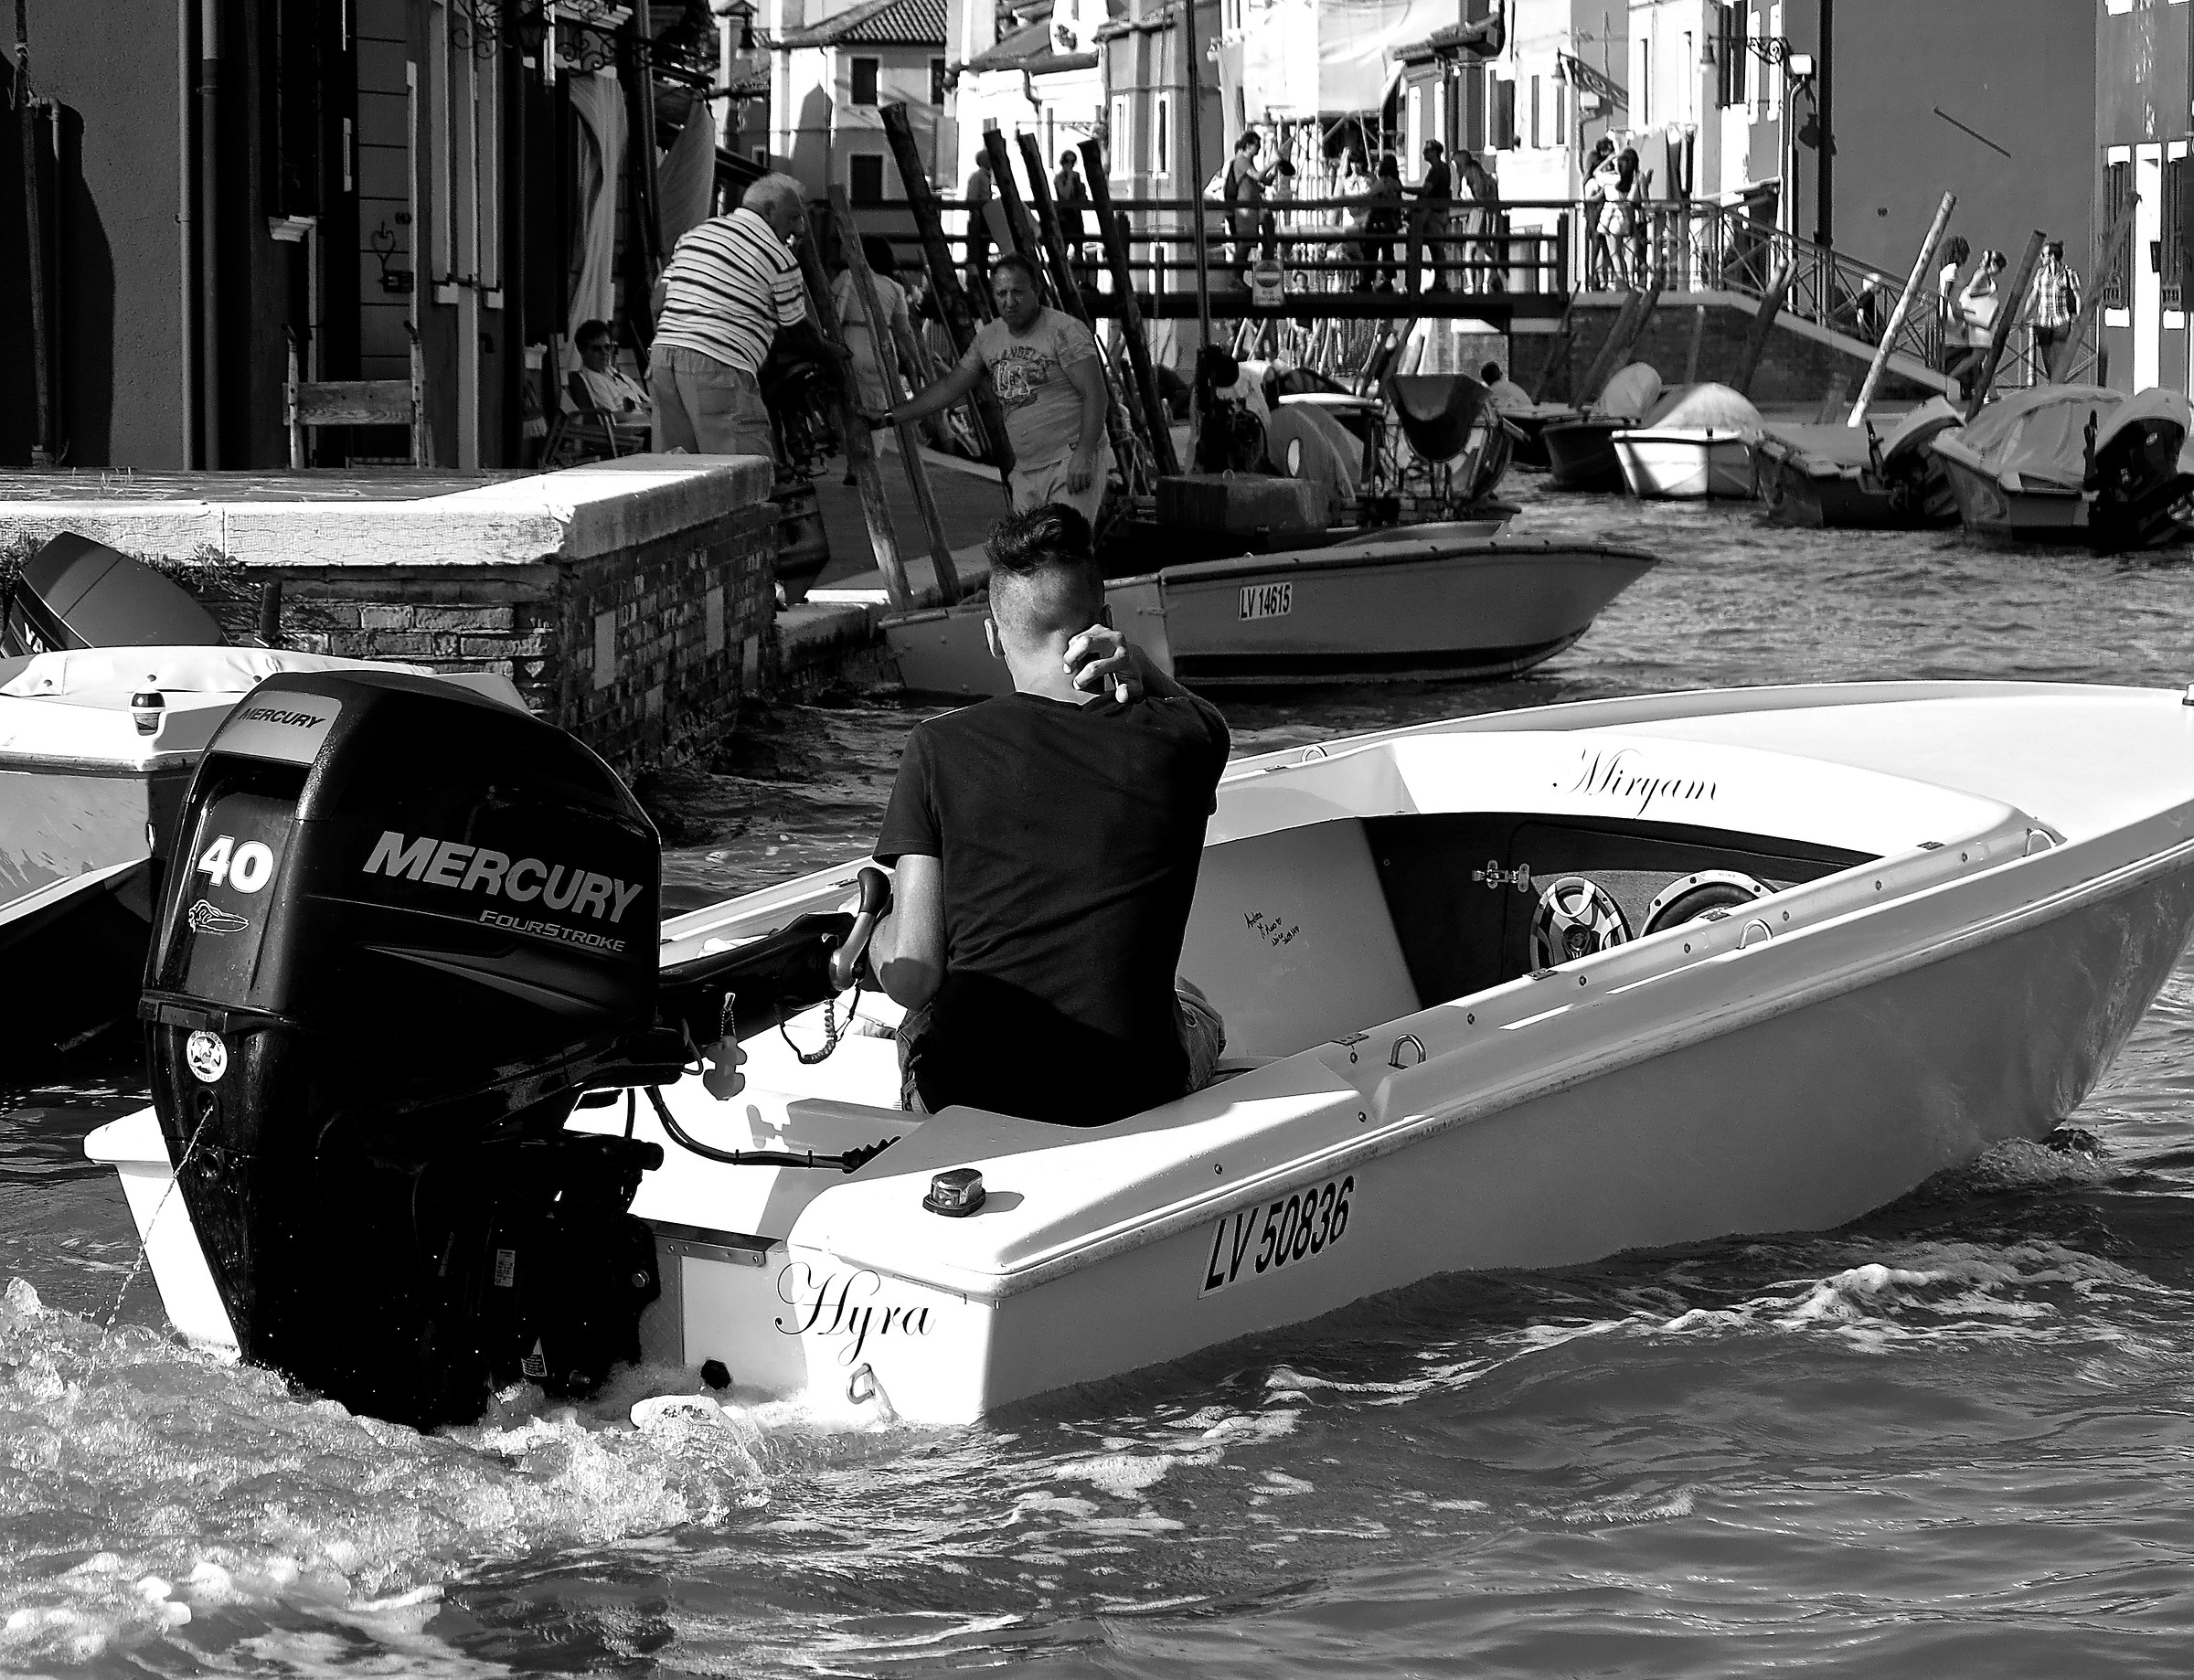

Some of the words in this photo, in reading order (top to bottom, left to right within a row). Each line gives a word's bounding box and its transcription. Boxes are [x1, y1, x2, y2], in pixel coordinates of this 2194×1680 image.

[1241, 588, 1256, 618] LV
[1259, 584, 1291, 616] 14615
[24, 622, 52, 654] YA
[238, 707, 326, 728] MERCURY
[1552, 748, 1717, 819] Miryam
[196, 834, 274, 894] 40
[363, 830, 644, 923] MERCURY
[1203, 1207, 1260, 1292] LV
[1254, 1175, 1355, 1274] 50836
[774, 1261, 937, 1367] Hyra
